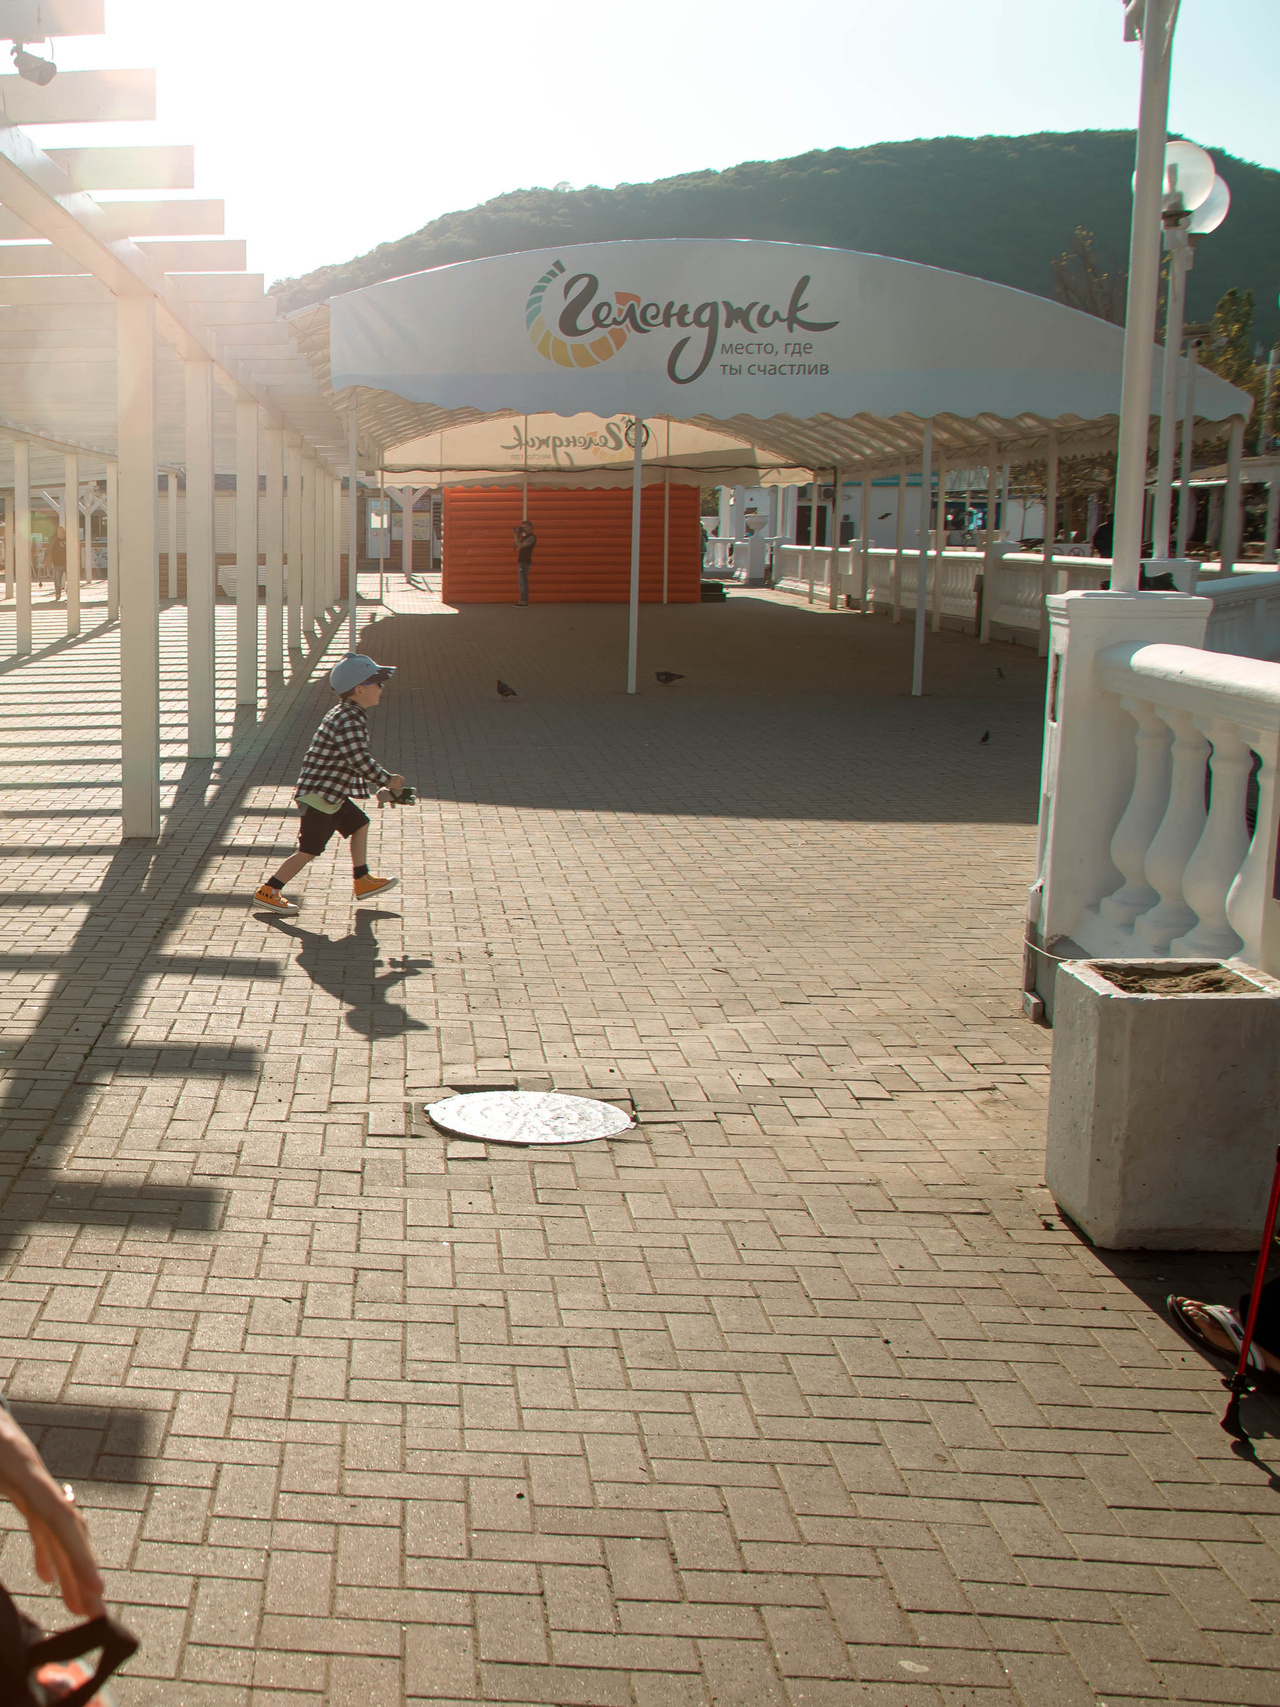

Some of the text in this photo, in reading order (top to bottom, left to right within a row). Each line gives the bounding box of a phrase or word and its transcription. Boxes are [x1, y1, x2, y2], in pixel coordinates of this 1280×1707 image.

[558, 273, 840, 385] Геленджик
[720, 342, 813, 357] место, где
[720, 364, 830, 375] ты счастлив
